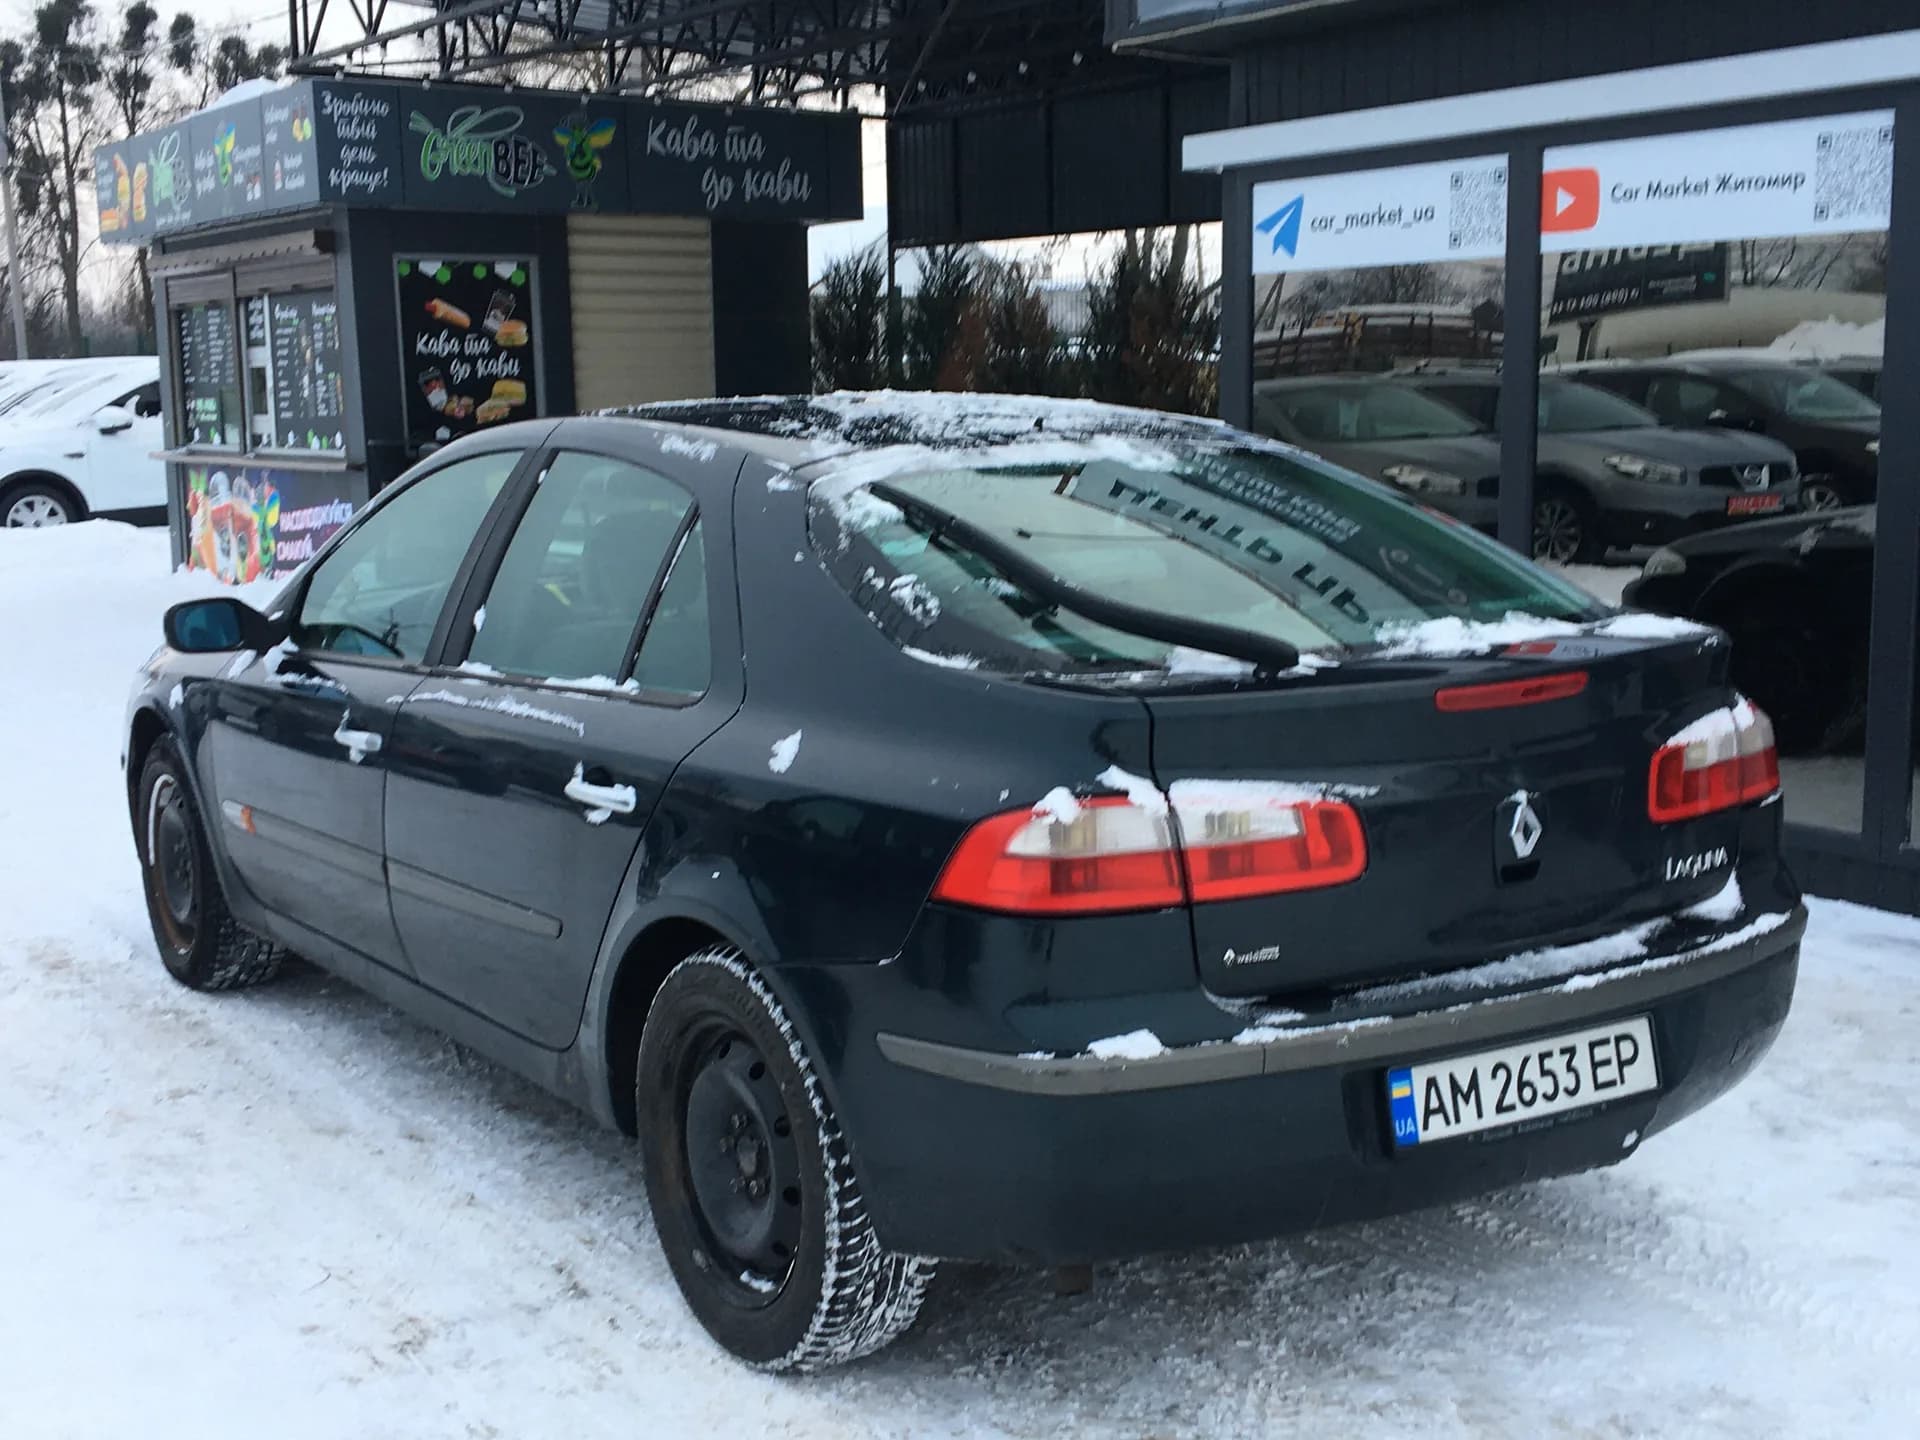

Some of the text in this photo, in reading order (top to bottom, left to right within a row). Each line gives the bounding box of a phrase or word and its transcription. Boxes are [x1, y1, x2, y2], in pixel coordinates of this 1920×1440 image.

[321, 90, 390, 123] Зробимо
[337, 115, 378, 140] твій
[646, 115, 767, 163] Кава та
[340, 144, 377, 168] день
[328, 167, 389, 195] краще!
[702, 155, 813, 211] до кави
[1611, 172, 1806, 204] Car Market Житомир
[1311, 202, 1436, 235] car_market_ua
[416, 328, 492, 358] Кава та
[450, 349, 521, 385] до кави
[1665, 846, 1729, 881] LAGUNA
[1422, 1066, 1484, 1132] AM
[1490, 1044, 1582, 1115] 2653
[1588, 1032, 1640, 1092] EP
[1395, 1119, 1417, 1137] UA
